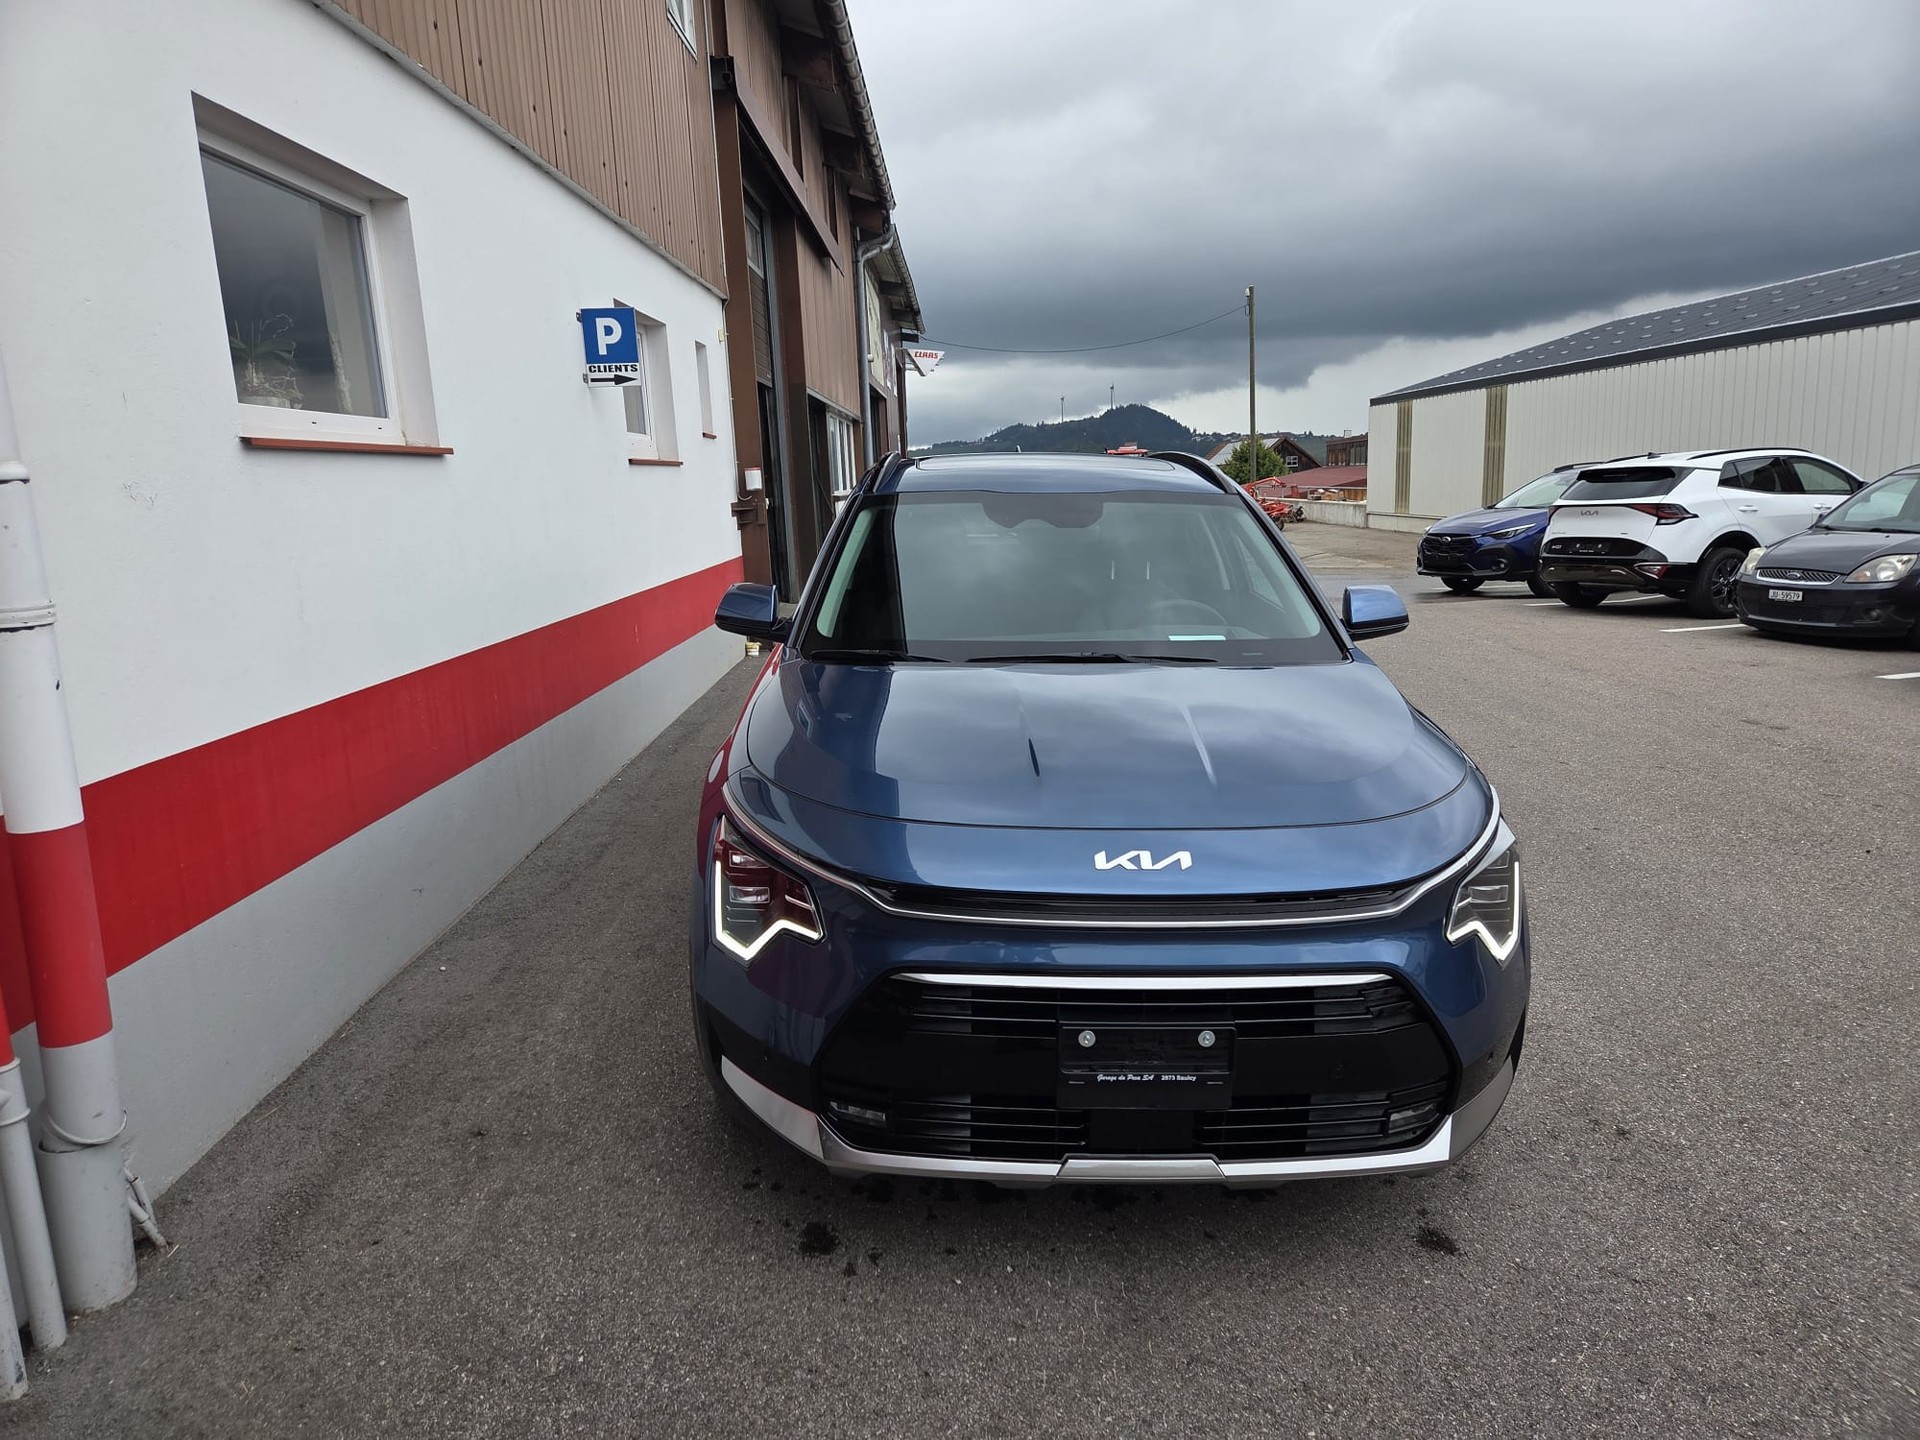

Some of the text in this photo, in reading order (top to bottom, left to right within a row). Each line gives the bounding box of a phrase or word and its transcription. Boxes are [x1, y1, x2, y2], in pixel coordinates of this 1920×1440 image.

[595, 317, 622, 355] P
[914, 351, 939, 359] CLAAS
[588, 364, 638, 373] CLIENTS
[1094, 850, 1192, 870] KIA
[1097, 1074, 1117, 1082] Garage
